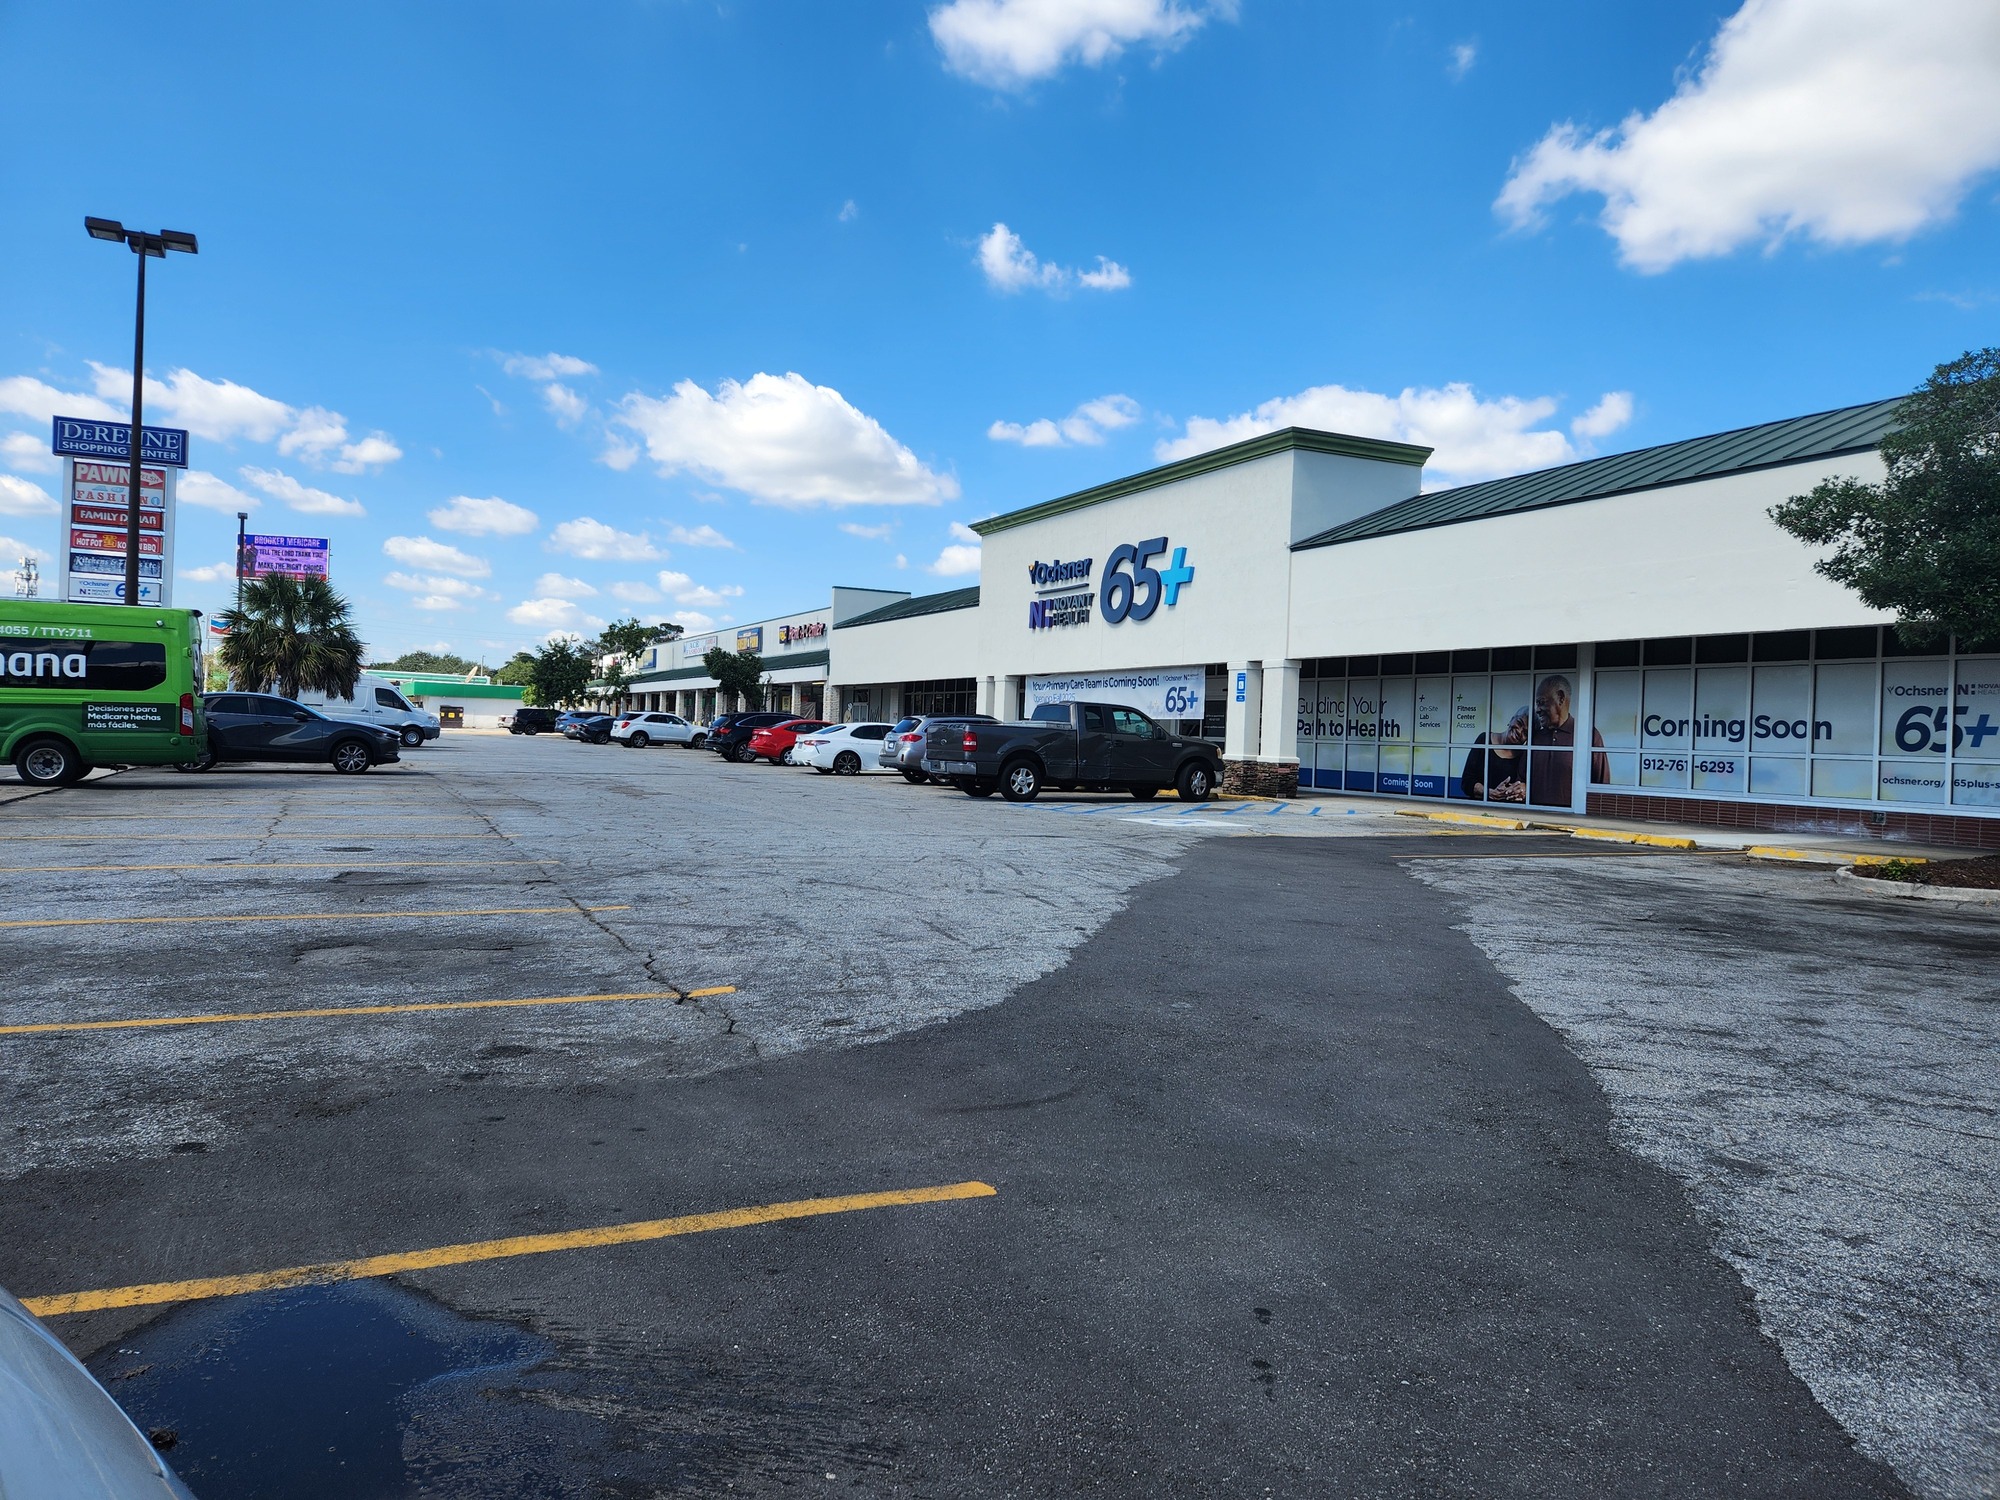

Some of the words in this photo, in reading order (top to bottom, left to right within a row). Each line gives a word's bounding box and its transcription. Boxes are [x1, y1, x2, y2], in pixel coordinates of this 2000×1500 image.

[62, 441, 127, 455] SHOPPING
[141, 449, 178, 460] ENTER
[76, 463, 131, 484] PAWN
[76, 489, 148, 505] FASHIN
[80, 510, 118, 521] FAMILY
[120, 513, 157, 525] DLAR
[76, 538, 89, 546] HOT
[90, 539, 102, 547] POT
[143, 544, 157, 552] BBQ
[1035, 558, 1093, 584] Ochsner
[1100, 536, 1195, 624] 65+
[115, 583, 150, 598] 6+
[1053, 593, 1095, 611] NOVANT
[1053, 609, 1091, 626] HEALTH
[40, 627, 92, 638] TTY:711
[1032, 681, 1046, 691] Your
[1046, 680, 1070, 692] Primary
[1070, 679, 1084, 690] Care
[1084, 678, 1102, 689] Team
[1102, 676, 1109, 688] is
[1109, 675, 1137, 690] Coming
[1137, 674, 1160, 687] Soon!
[1895, 685, 1949, 697] Ochsner
[87, 704, 135, 712] Decisiones
[1165, 686, 1199, 713] 65+
[1298, 696, 1345, 718] Guding
[1352, 696, 1387, 714] Your
[87, 712, 129, 720] Medicare
[130, 713, 162, 721] hechas
[107, 721, 139, 729] fáciles.
[1329, 719, 1345, 737] to
[1348, 718, 1401, 738] Health
[1643, 714, 1745, 743] Coming
[1753, 714, 1832, 739] Soon
[1895, 705, 1999, 753] 65+
[1643, 758, 1735, 774] 912-761-6293
[1382, 777, 1410, 788] Coming
[1414, 779, 1434, 788] Soon
